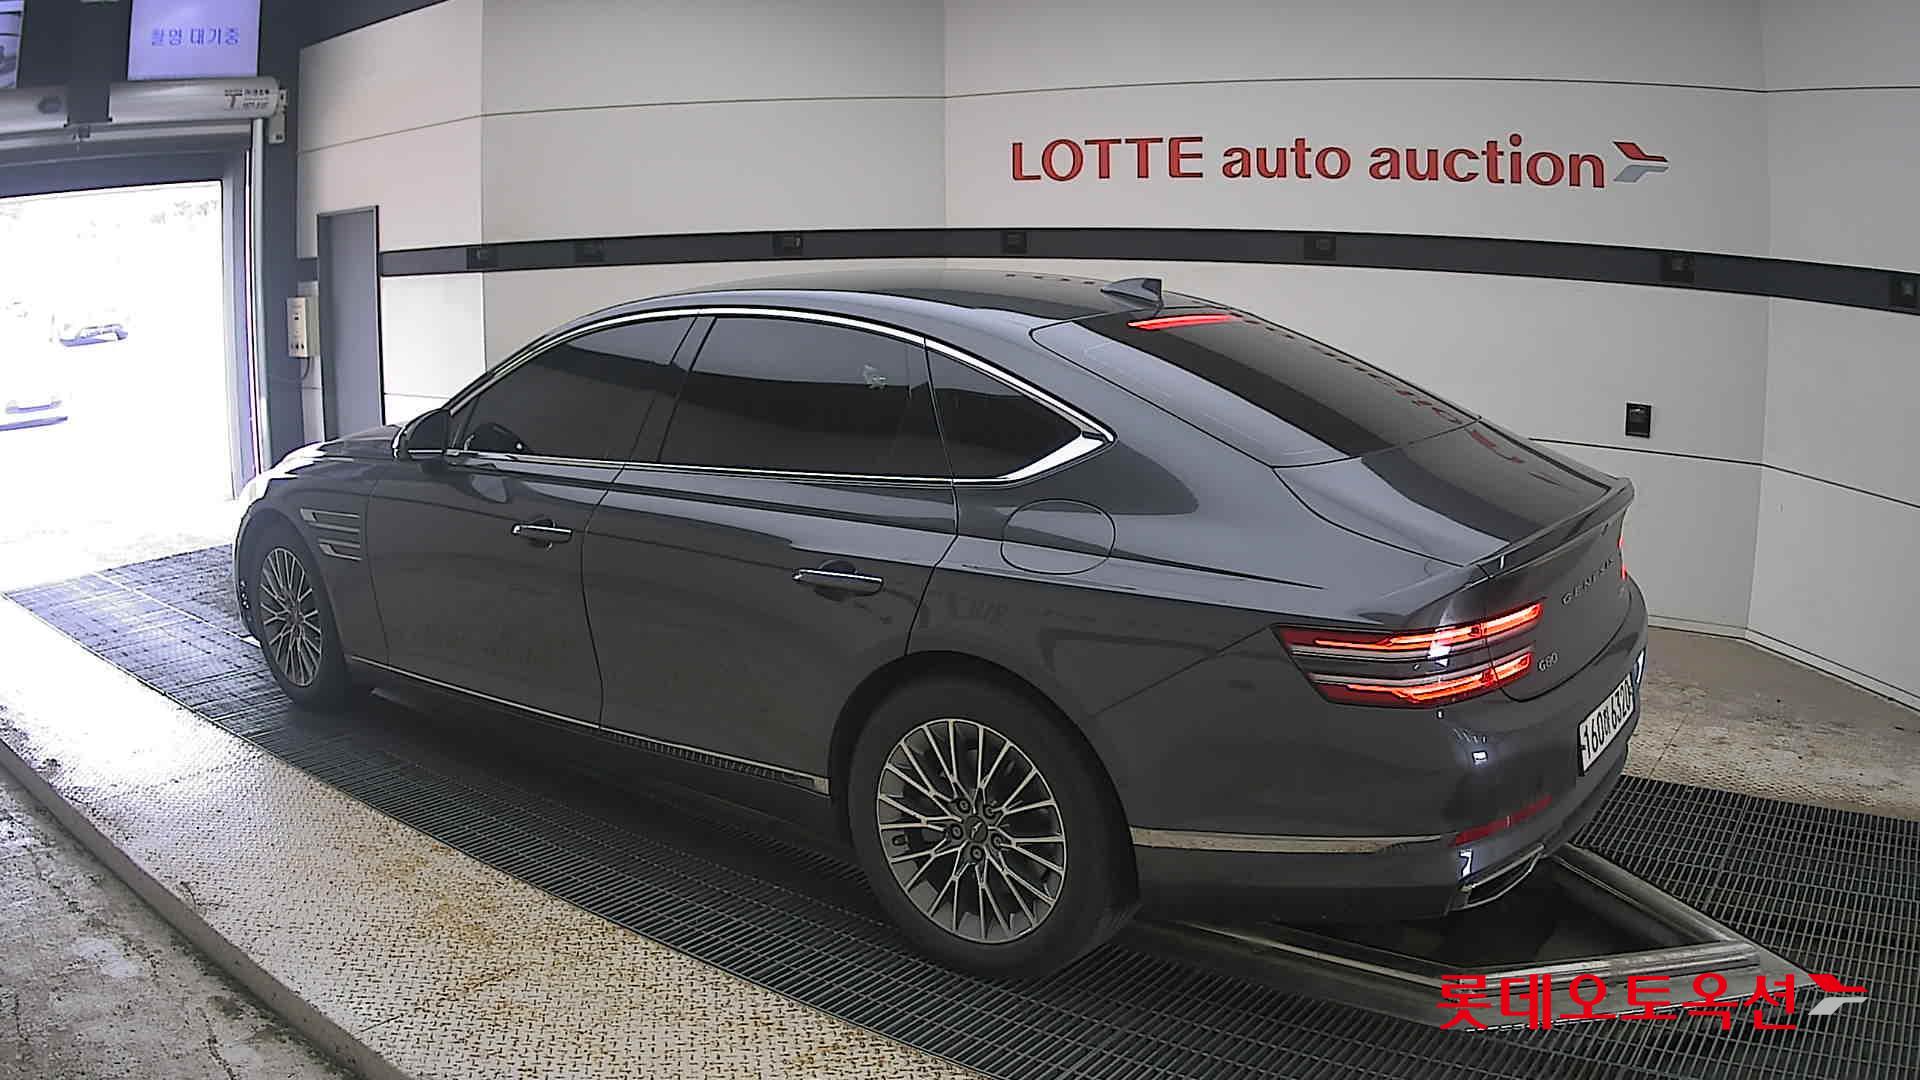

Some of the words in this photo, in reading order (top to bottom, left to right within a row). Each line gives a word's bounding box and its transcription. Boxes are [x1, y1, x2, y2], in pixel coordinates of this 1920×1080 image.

[190, 26, 240, 46] 대기중
[1011, 136, 1203, 182] LOTTE
[1221, 138, 1352, 179] auto
[1368, 133, 1606, 188] auction
